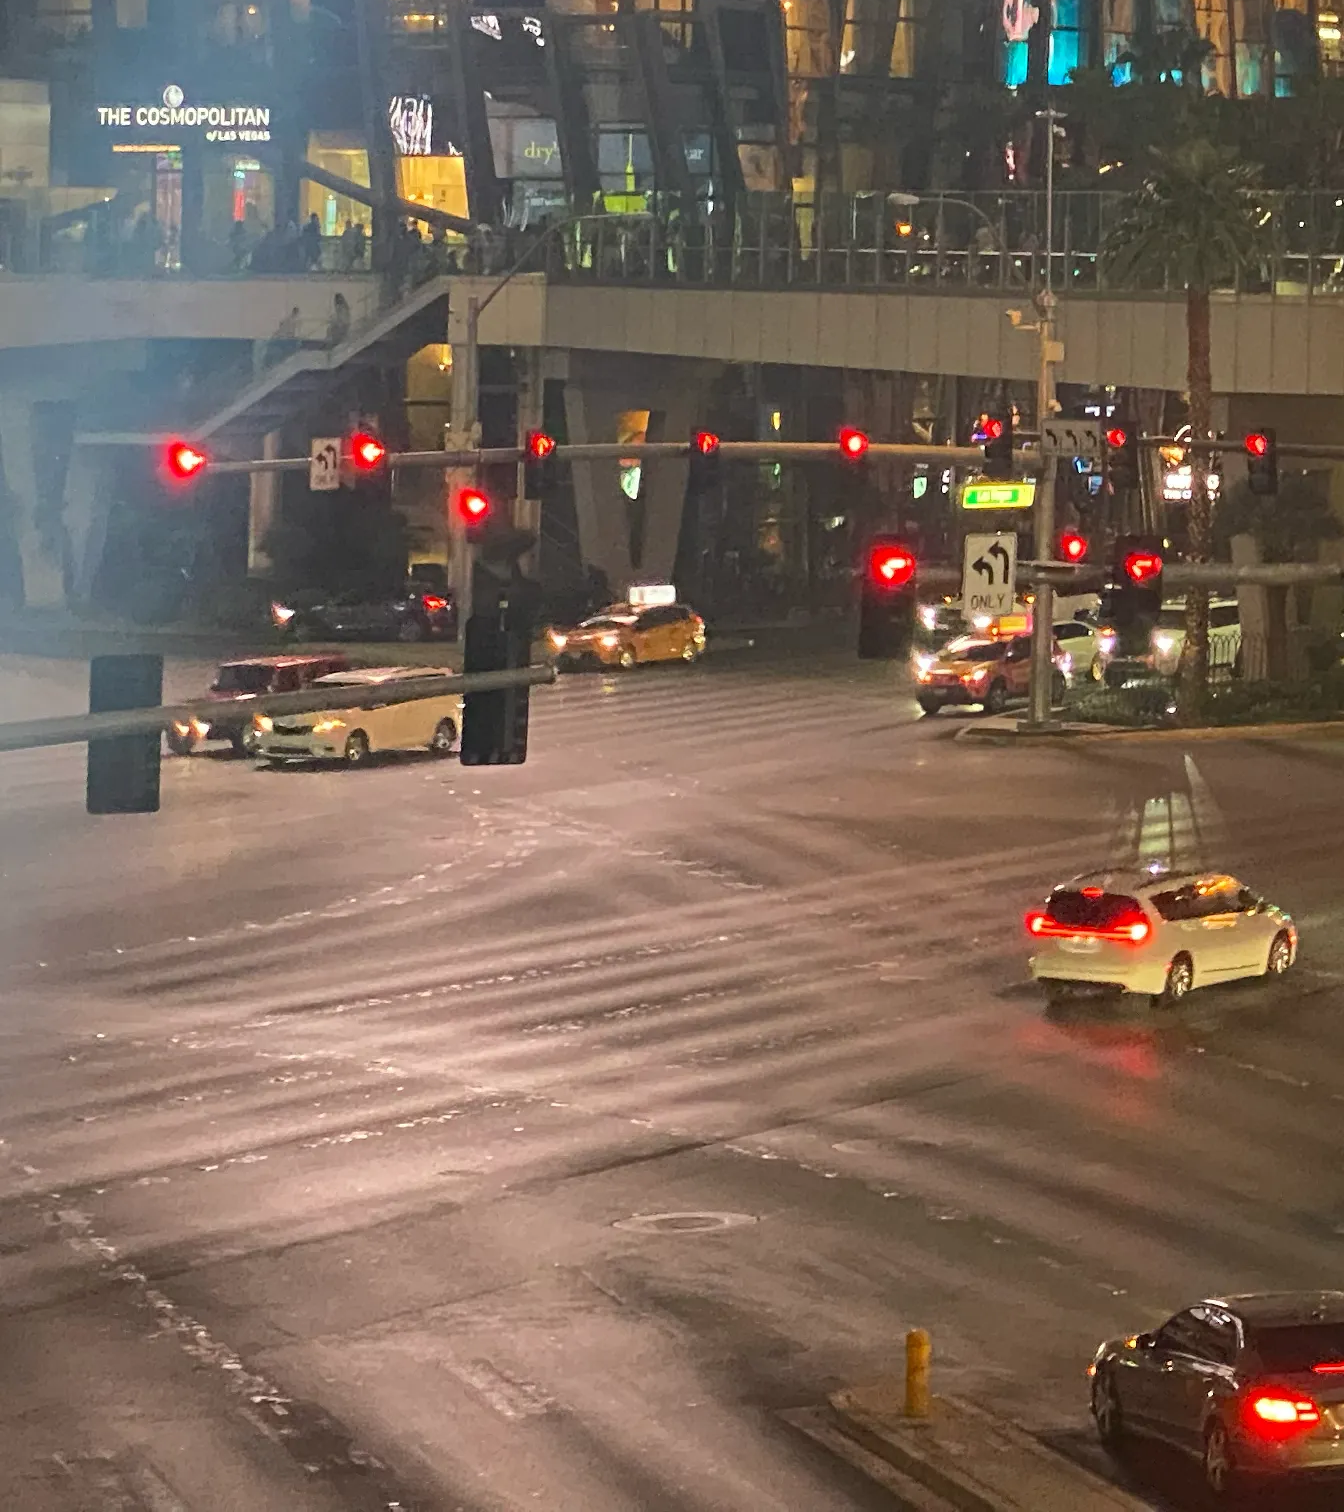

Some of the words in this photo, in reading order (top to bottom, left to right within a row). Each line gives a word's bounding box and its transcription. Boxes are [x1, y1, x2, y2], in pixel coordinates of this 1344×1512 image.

[98, 106, 131, 126] THE
[136, 106, 270, 127] COSMOPOLITAN
[971, 591, 1006, 609] ONLY
